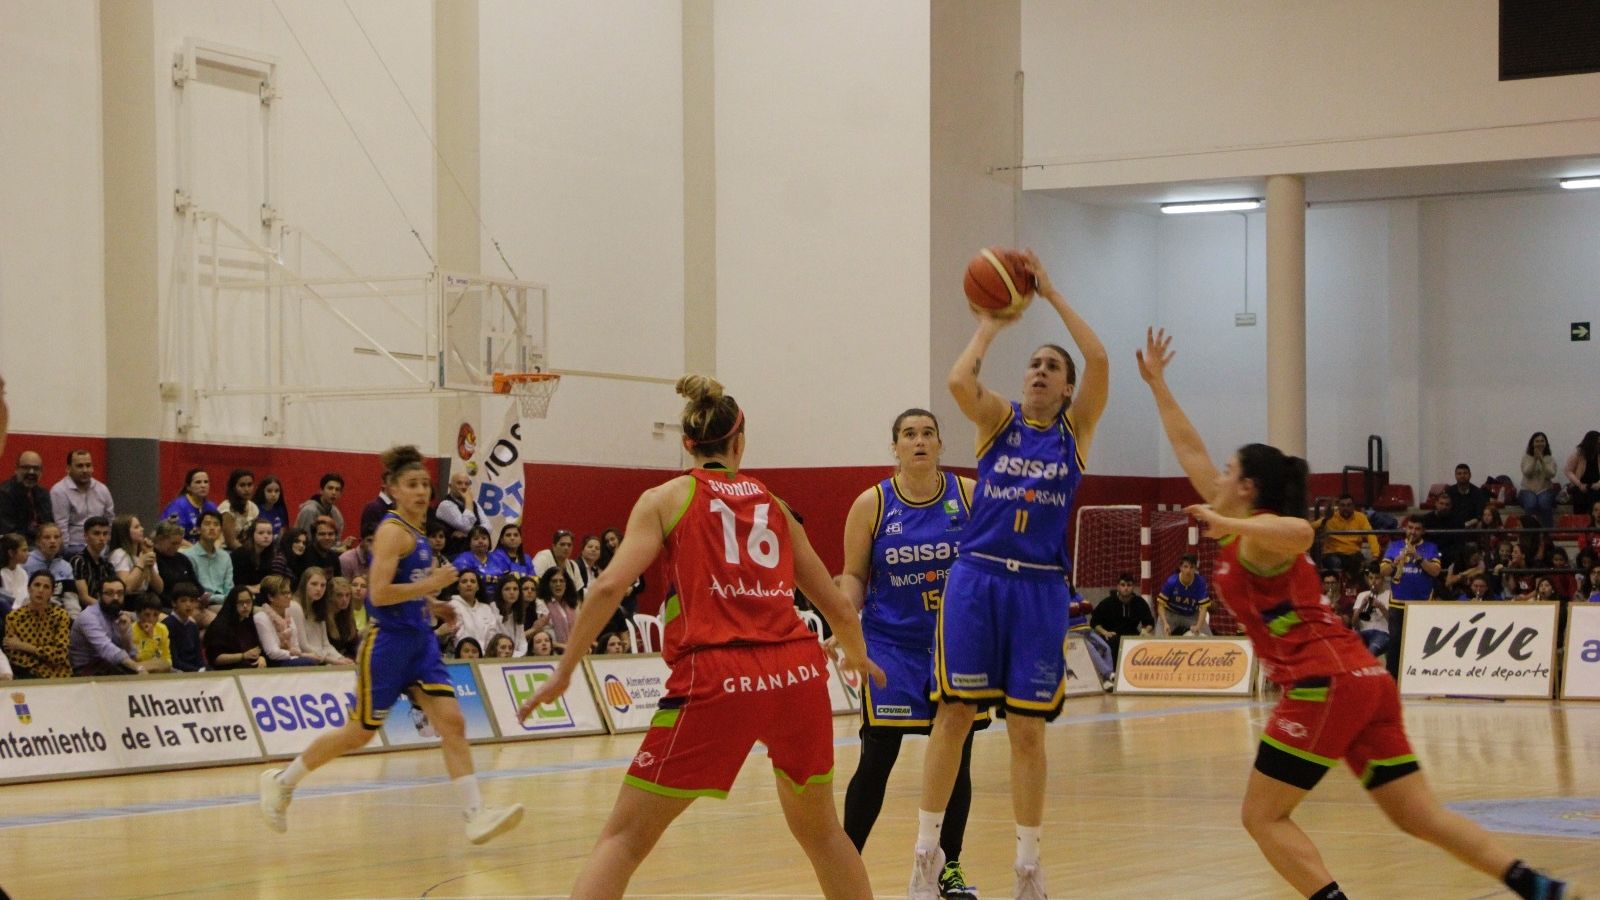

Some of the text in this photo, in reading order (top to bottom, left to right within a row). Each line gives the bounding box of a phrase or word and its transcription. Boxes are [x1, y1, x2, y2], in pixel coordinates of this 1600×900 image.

[993, 455, 1058, 480] asisa
[708, 479, 764, 497] SYDNOR
[1013, 508, 1028, 533] 11
[709, 498, 780, 569] 16
[885, 541, 951, 565] asisa
[709, 573, 795, 599] Andalucía
[921, 589, 940, 612] 15
[1131, 647, 1242, 672] Quality Closets
[1406, 663, 1549, 681] la marca del deporte
[456, 684, 477, 697] S.L.
[723, 664, 820, 693] GRANADA
[128, 691, 225, 718] Alhaurín
[251, 693, 346, 732] asisa
[121, 722, 248, 751] de la Torre
